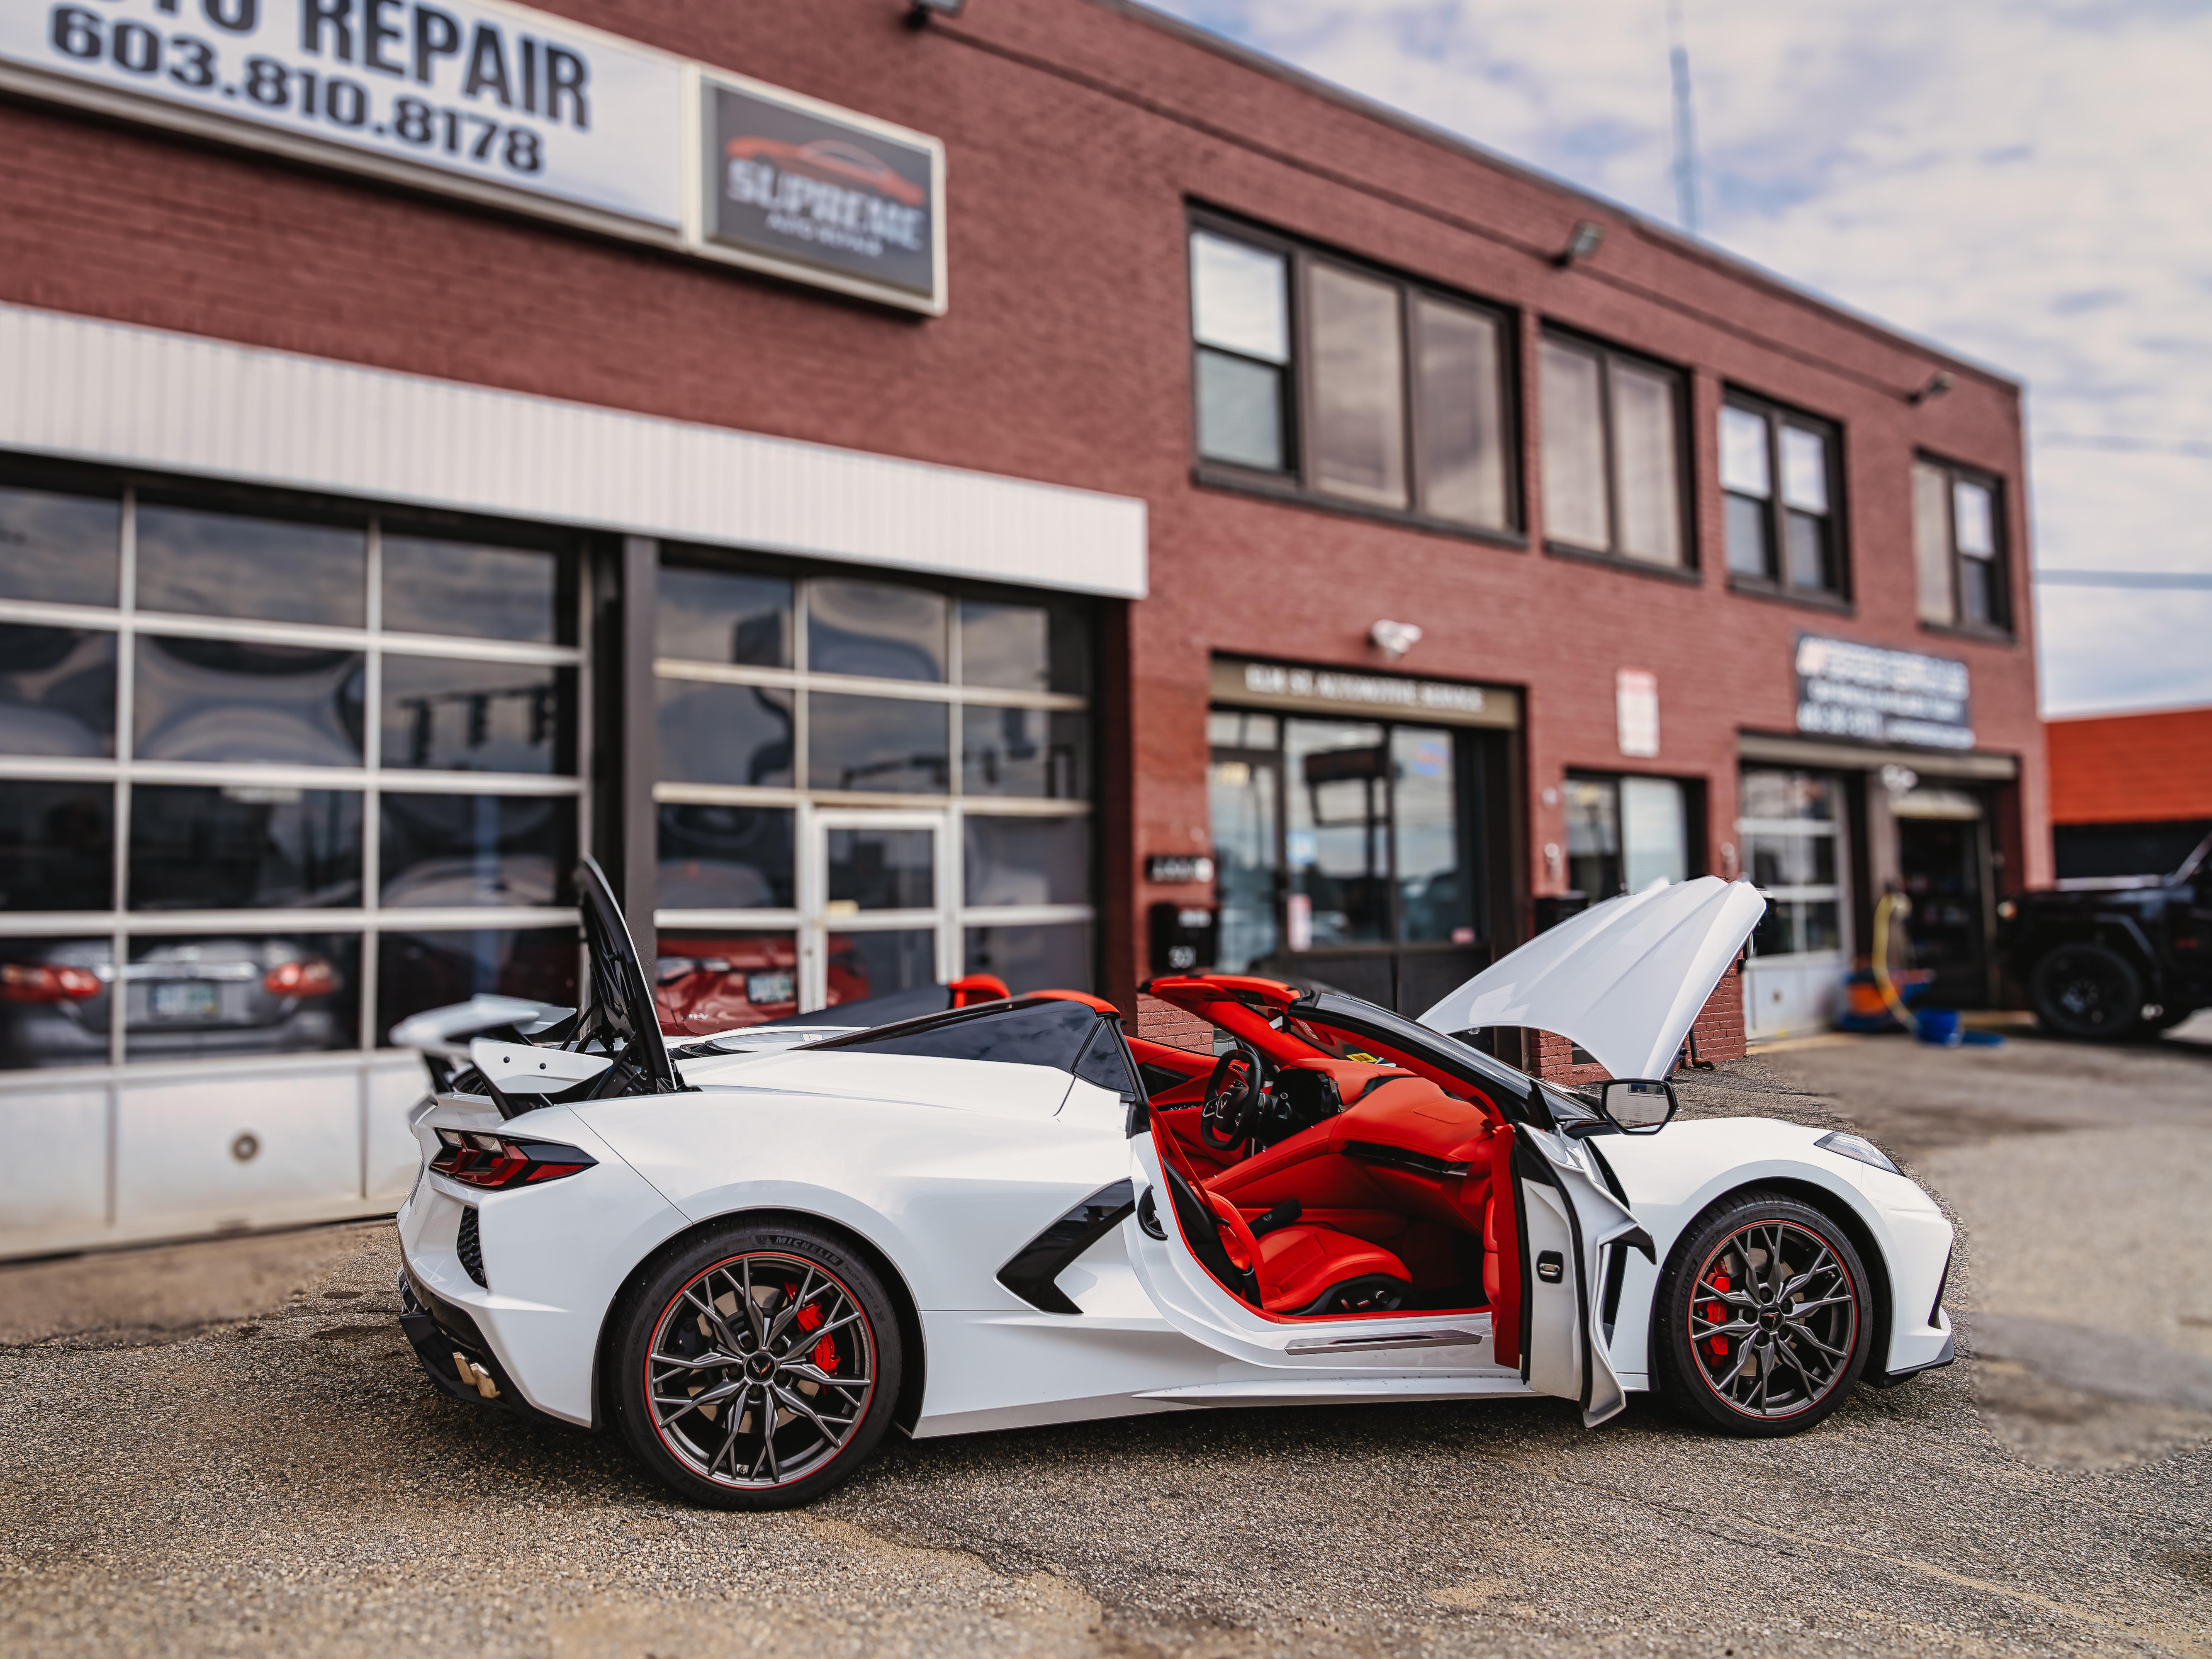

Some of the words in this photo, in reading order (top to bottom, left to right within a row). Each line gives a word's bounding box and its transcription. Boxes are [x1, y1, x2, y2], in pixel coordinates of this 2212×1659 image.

[51, 5, 543, 173] 603.810.8178
[301, 0, 589, 131] REPAIR
[727, 158, 925, 250] SUPREME
[775, 1236, 840, 1263] MICHELIN
[844, 1266, 859, 1280] PILOT
[859, 1281, 874, 1299] SPORT
[859, 1325, 870, 1373] CORVETTE
